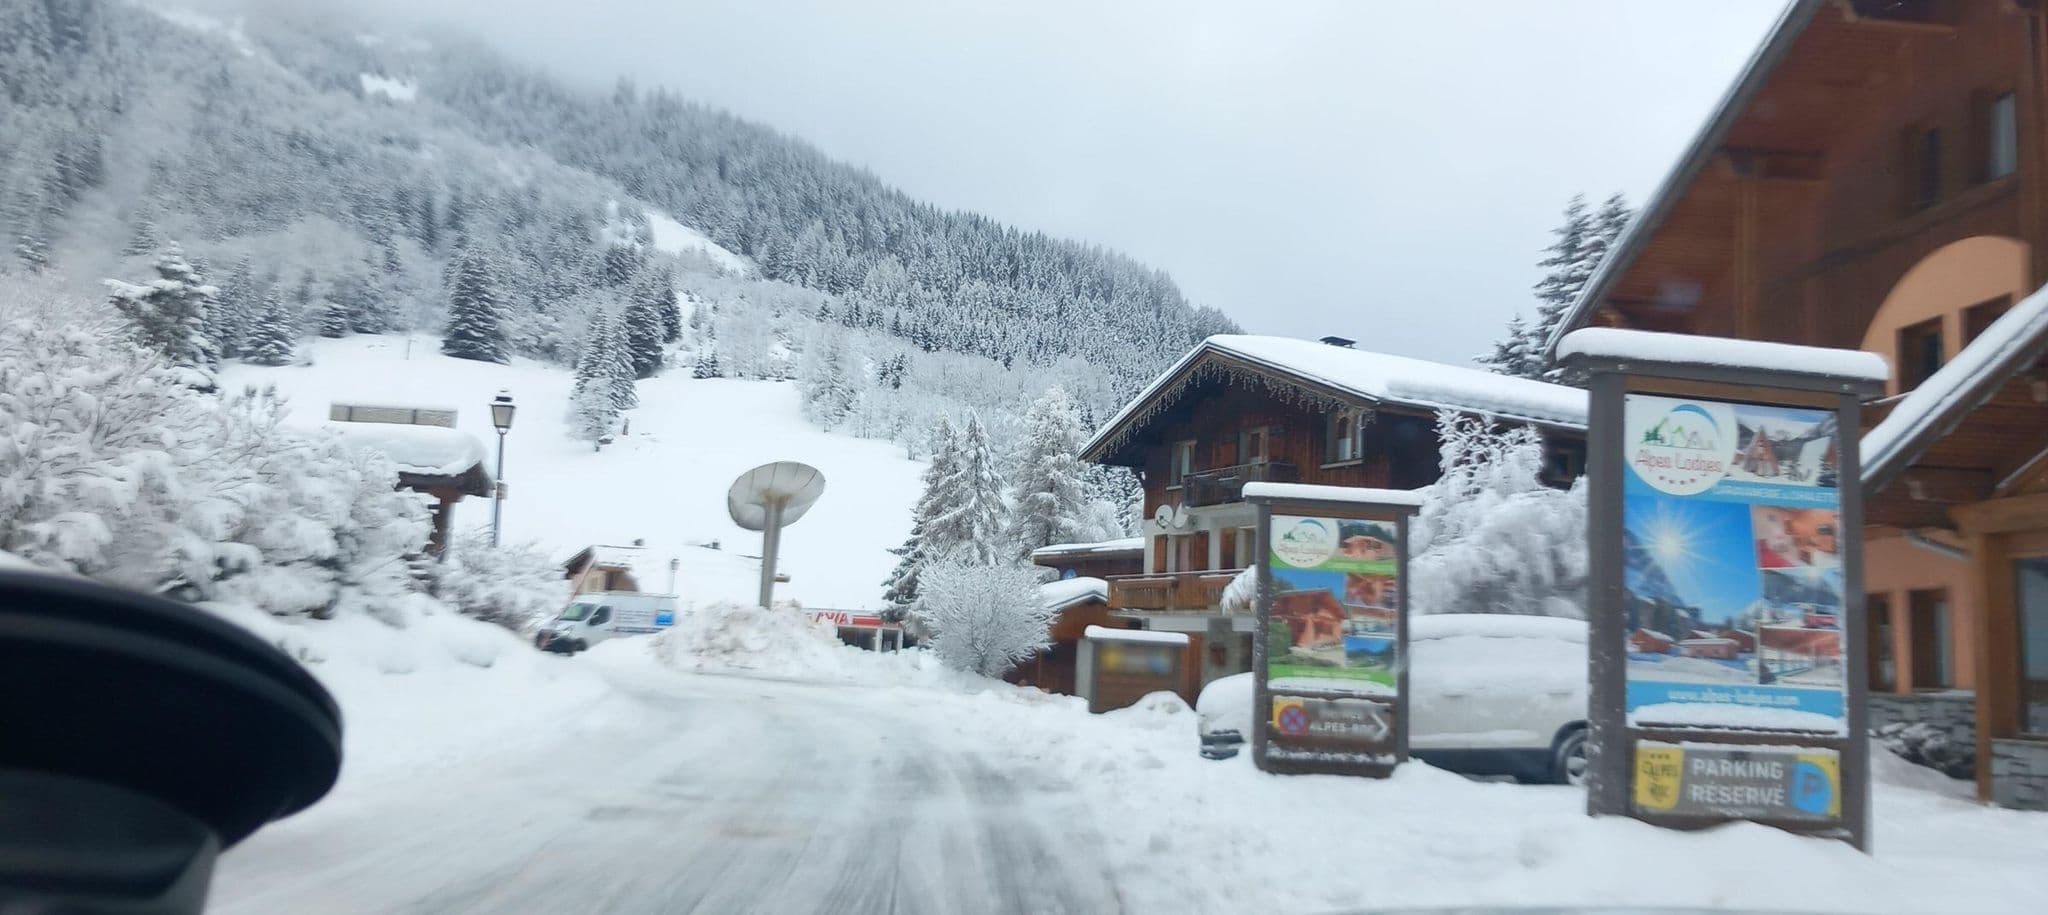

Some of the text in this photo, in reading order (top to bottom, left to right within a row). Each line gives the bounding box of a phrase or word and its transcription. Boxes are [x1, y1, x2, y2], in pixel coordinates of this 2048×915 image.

[1635, 448, 1722, 476] Alpes Lodges
[1692, 757, 1784, 780] PARKING
[1690, 780, 1785, 806] RÉSERVÉ
